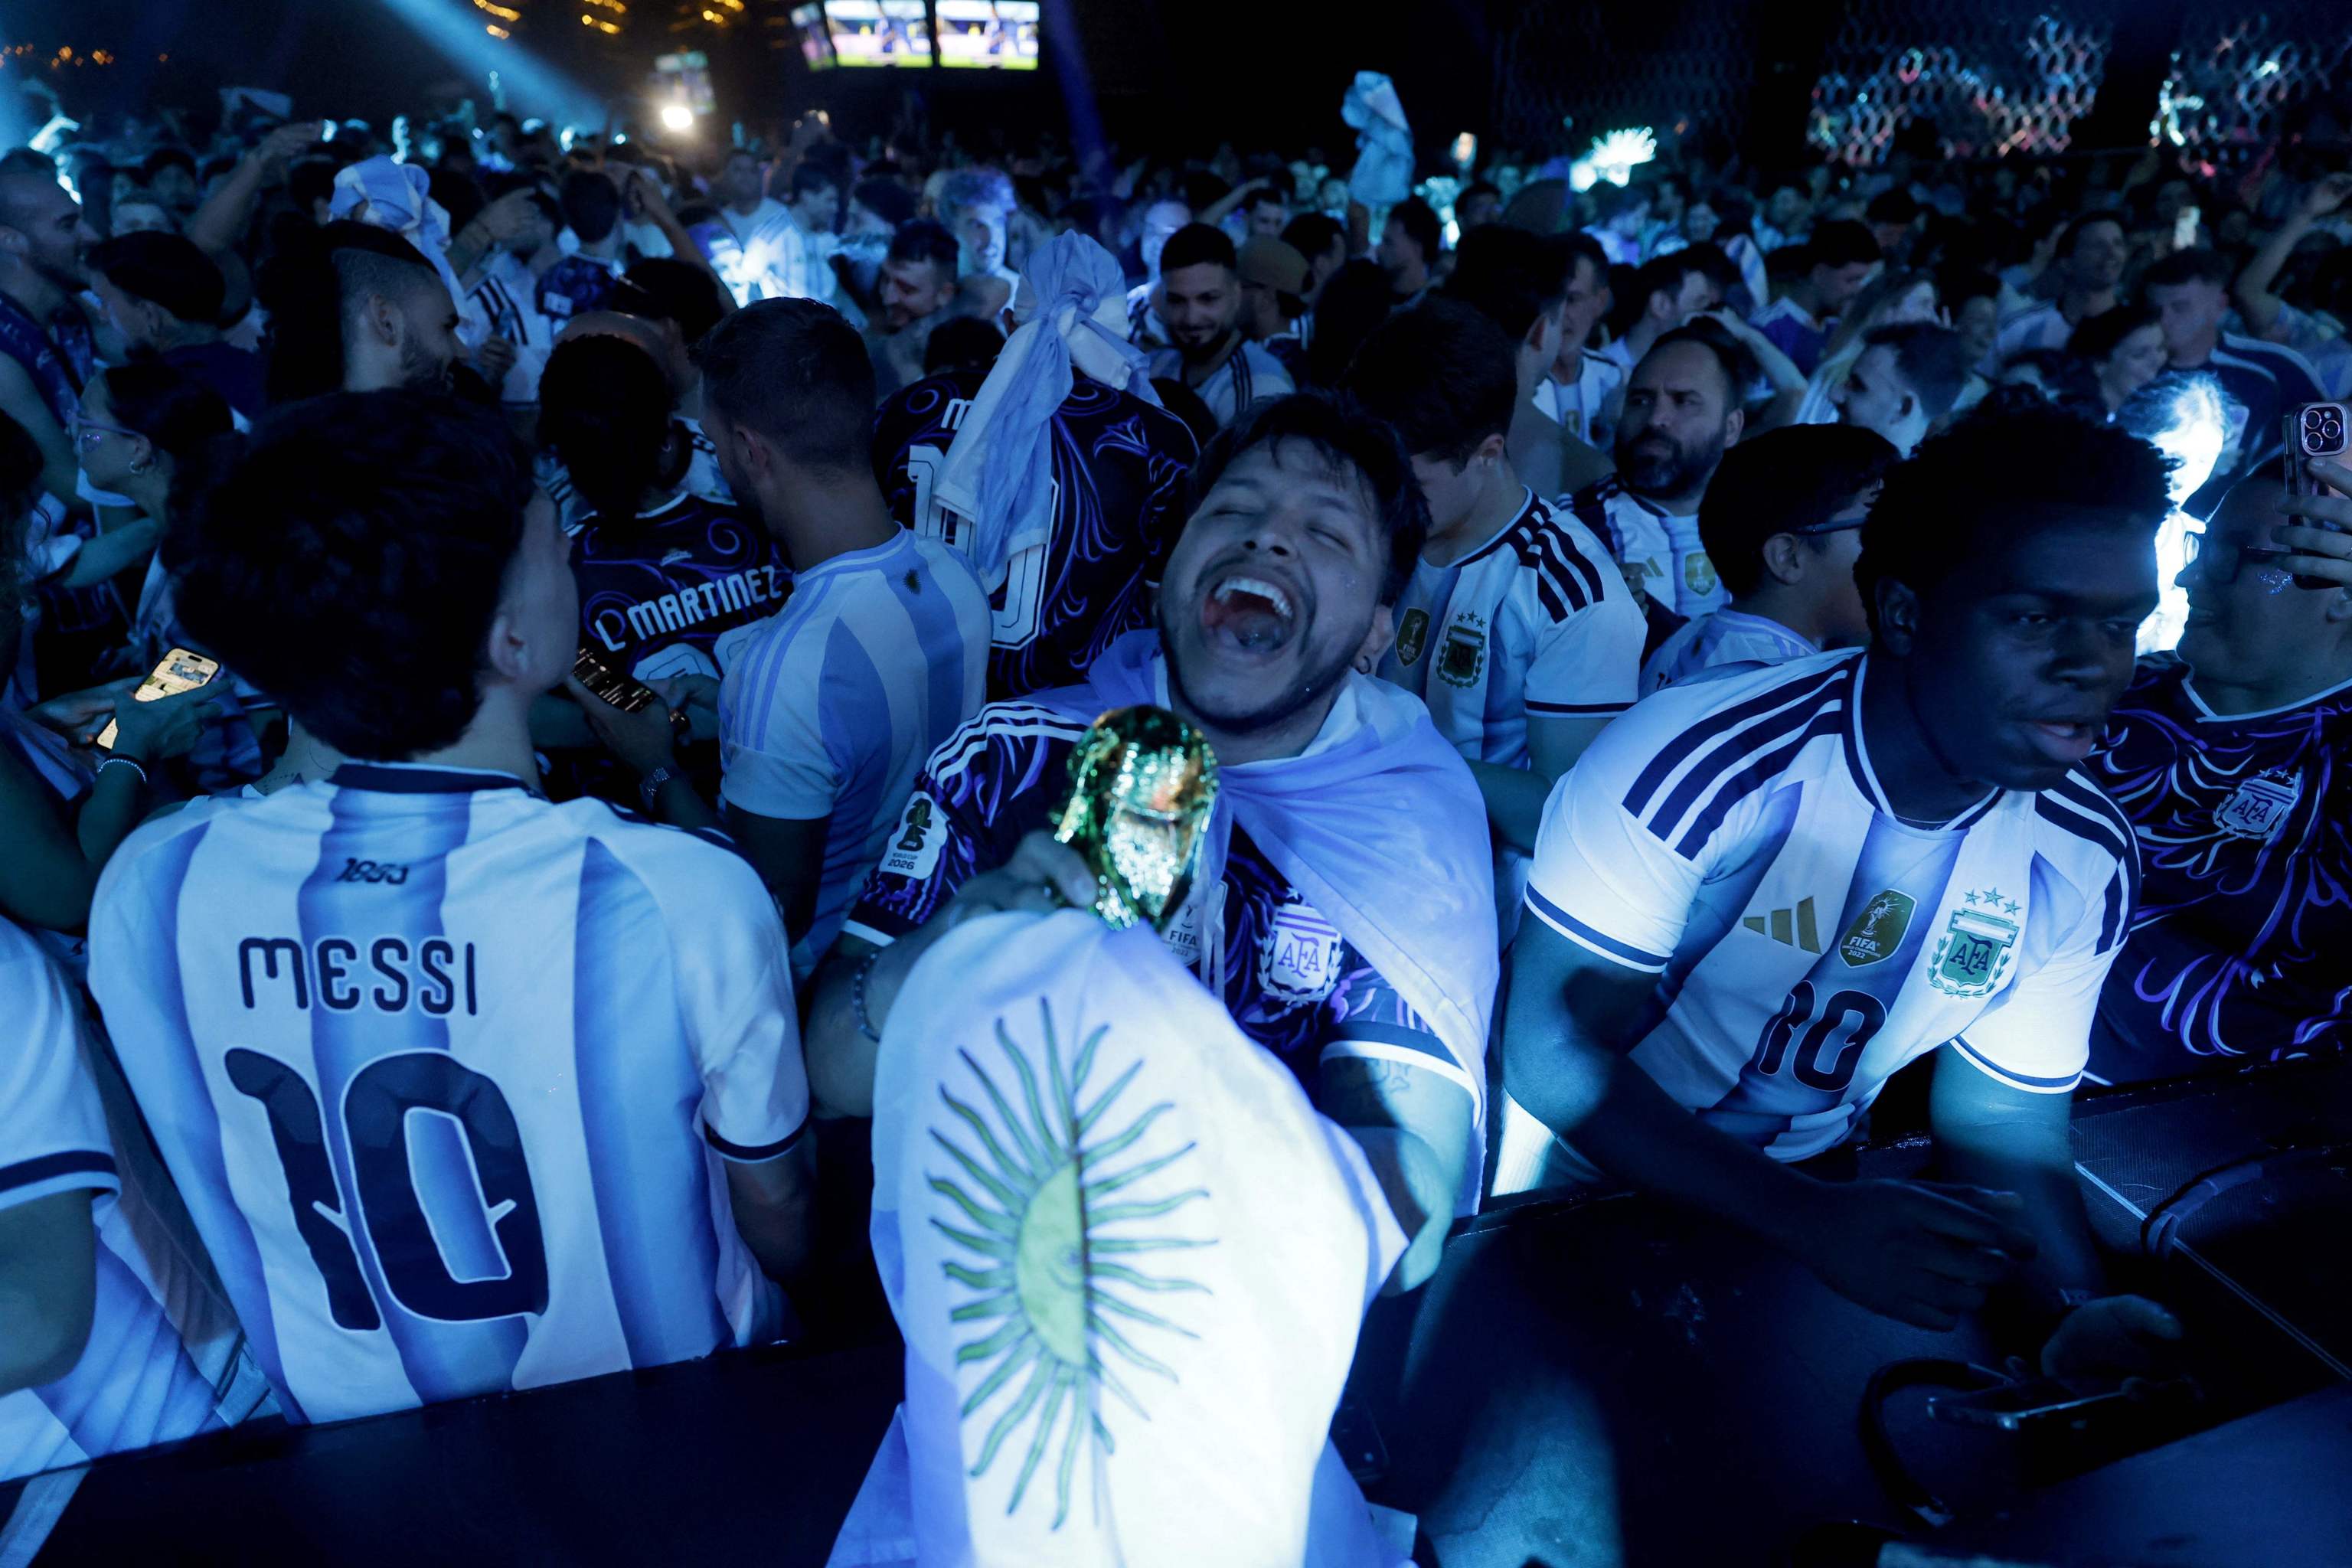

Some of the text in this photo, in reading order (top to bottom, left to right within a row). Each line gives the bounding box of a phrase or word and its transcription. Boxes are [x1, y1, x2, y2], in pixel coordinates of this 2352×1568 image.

[595, 565, 782, 652] L MARTINEZ
[2233, 794, 2273, 824] AFA
[888, 859, 915, 870] 2026
[1170, 930, 1196, 946] FIFA
[1278, 932, 1321, 978] AFA
[1847, 949, 1866, 959] 2022
[1949, 934, 1992, 975] AFA
[239, 938, 476, 1016] MESSI
[1758, 980, 1887, 1092] 10
[225, 1047, 550, 1331] 10
